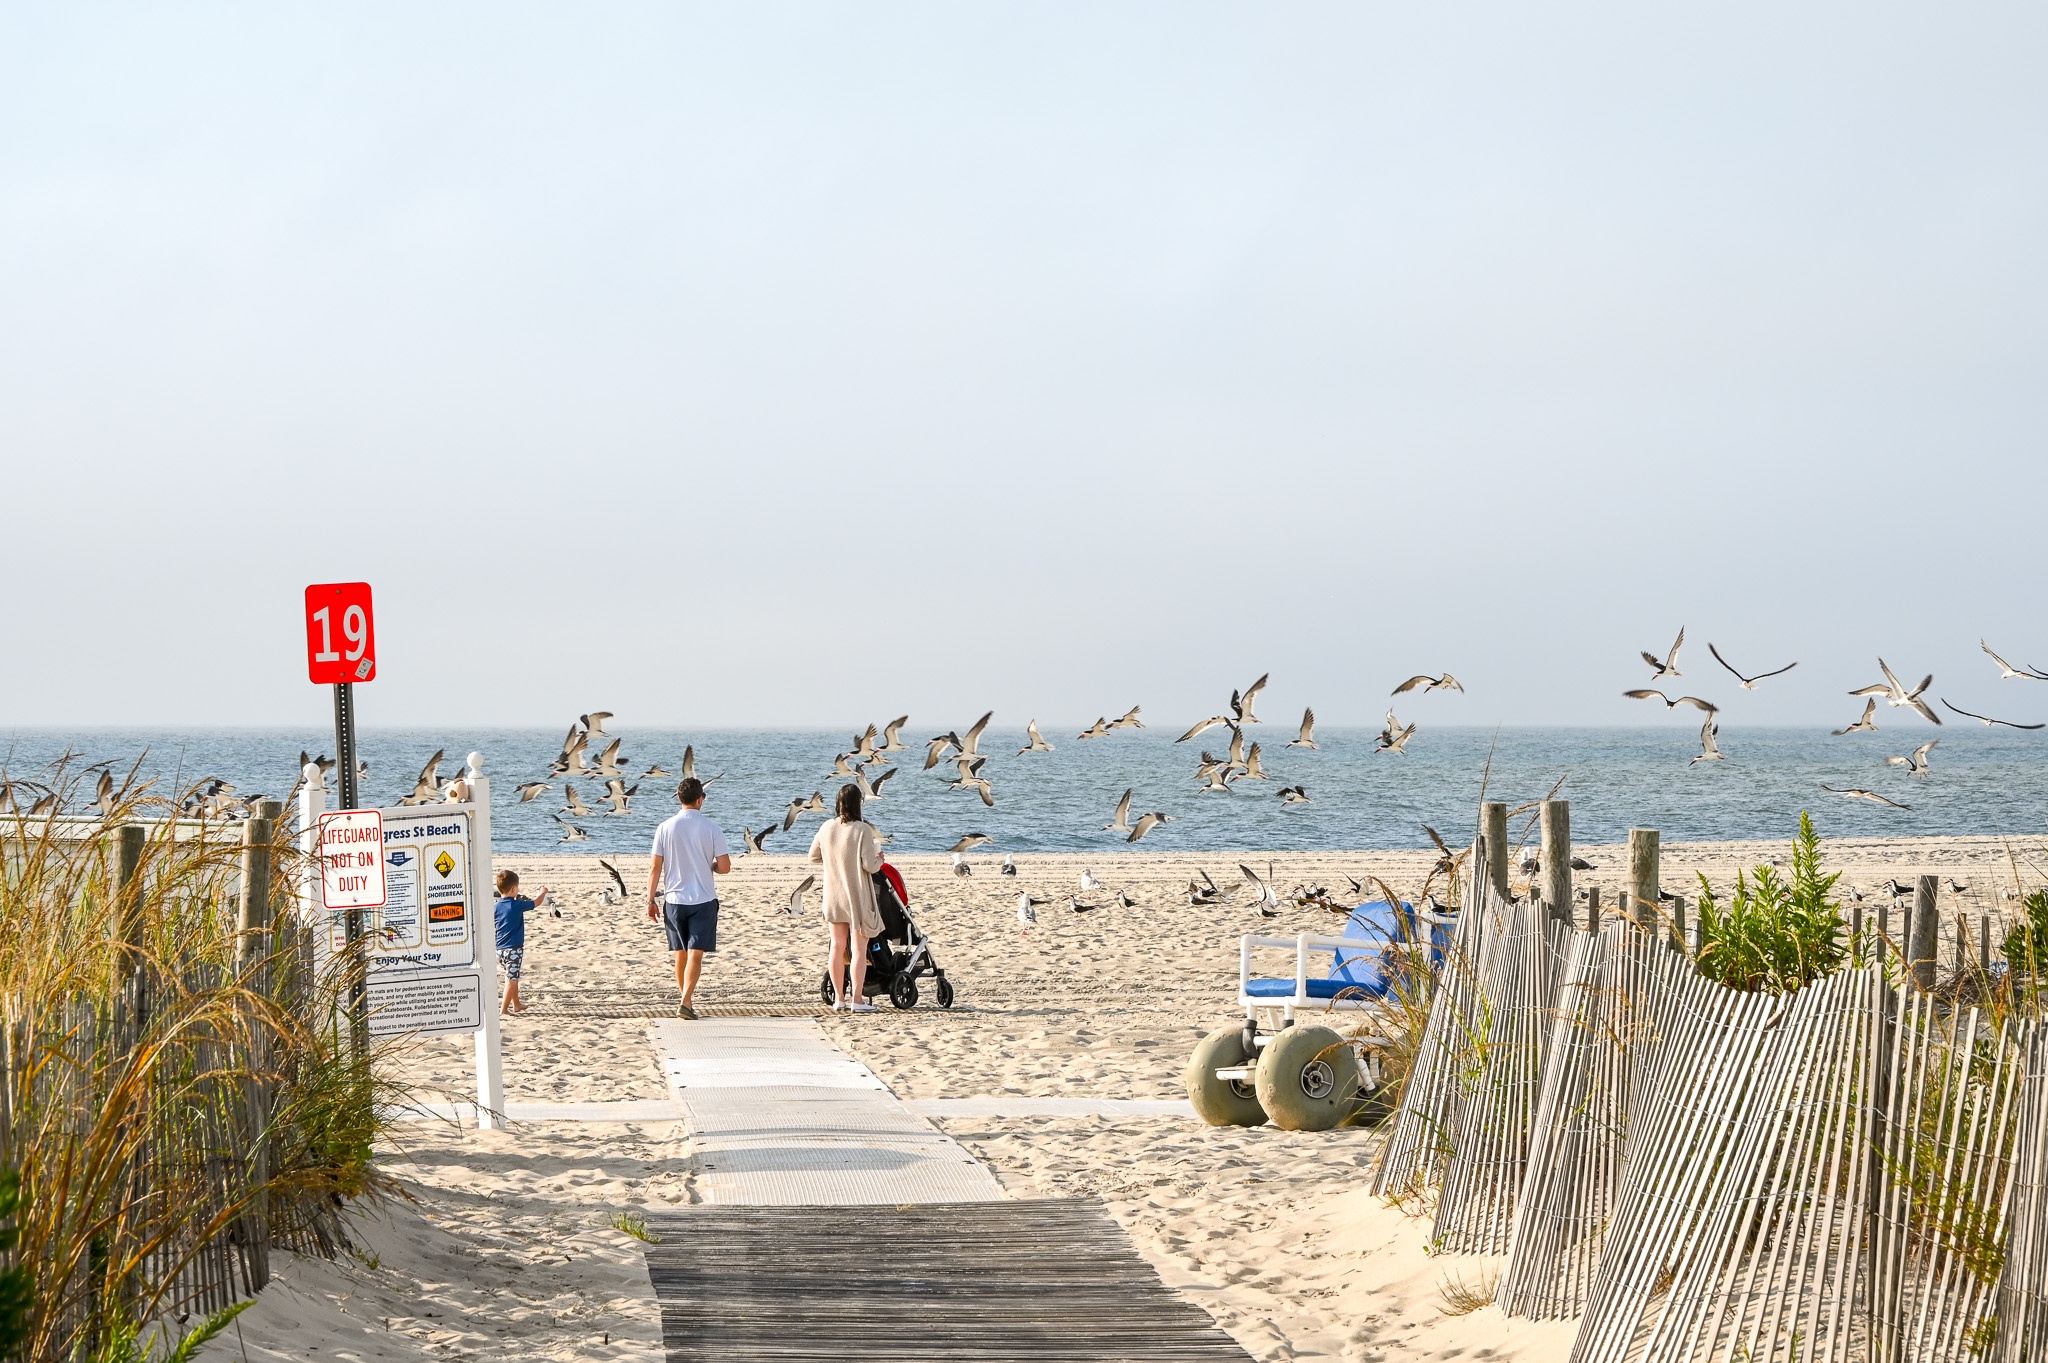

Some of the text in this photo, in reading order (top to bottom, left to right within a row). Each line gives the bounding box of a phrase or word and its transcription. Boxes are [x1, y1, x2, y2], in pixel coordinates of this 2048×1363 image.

[313, 604, 368, 662] 19
[323, 827, 379, 844] LIFEGUARD
[413, 826, 425, 837] St
[427, 823, 461, 836] Beach
[331, 851, 373, 868] NOT ON
[339, 875, 368, 892] DUTY
[428, 883, 462, 891] DANGEROUS
[428, 890, 464, 898] SHOREBREAK
[434, 908, 460, 917] WARNING
[376, 957, 400, 966] Enjoy
[424, 953, 442, 962] Stay
